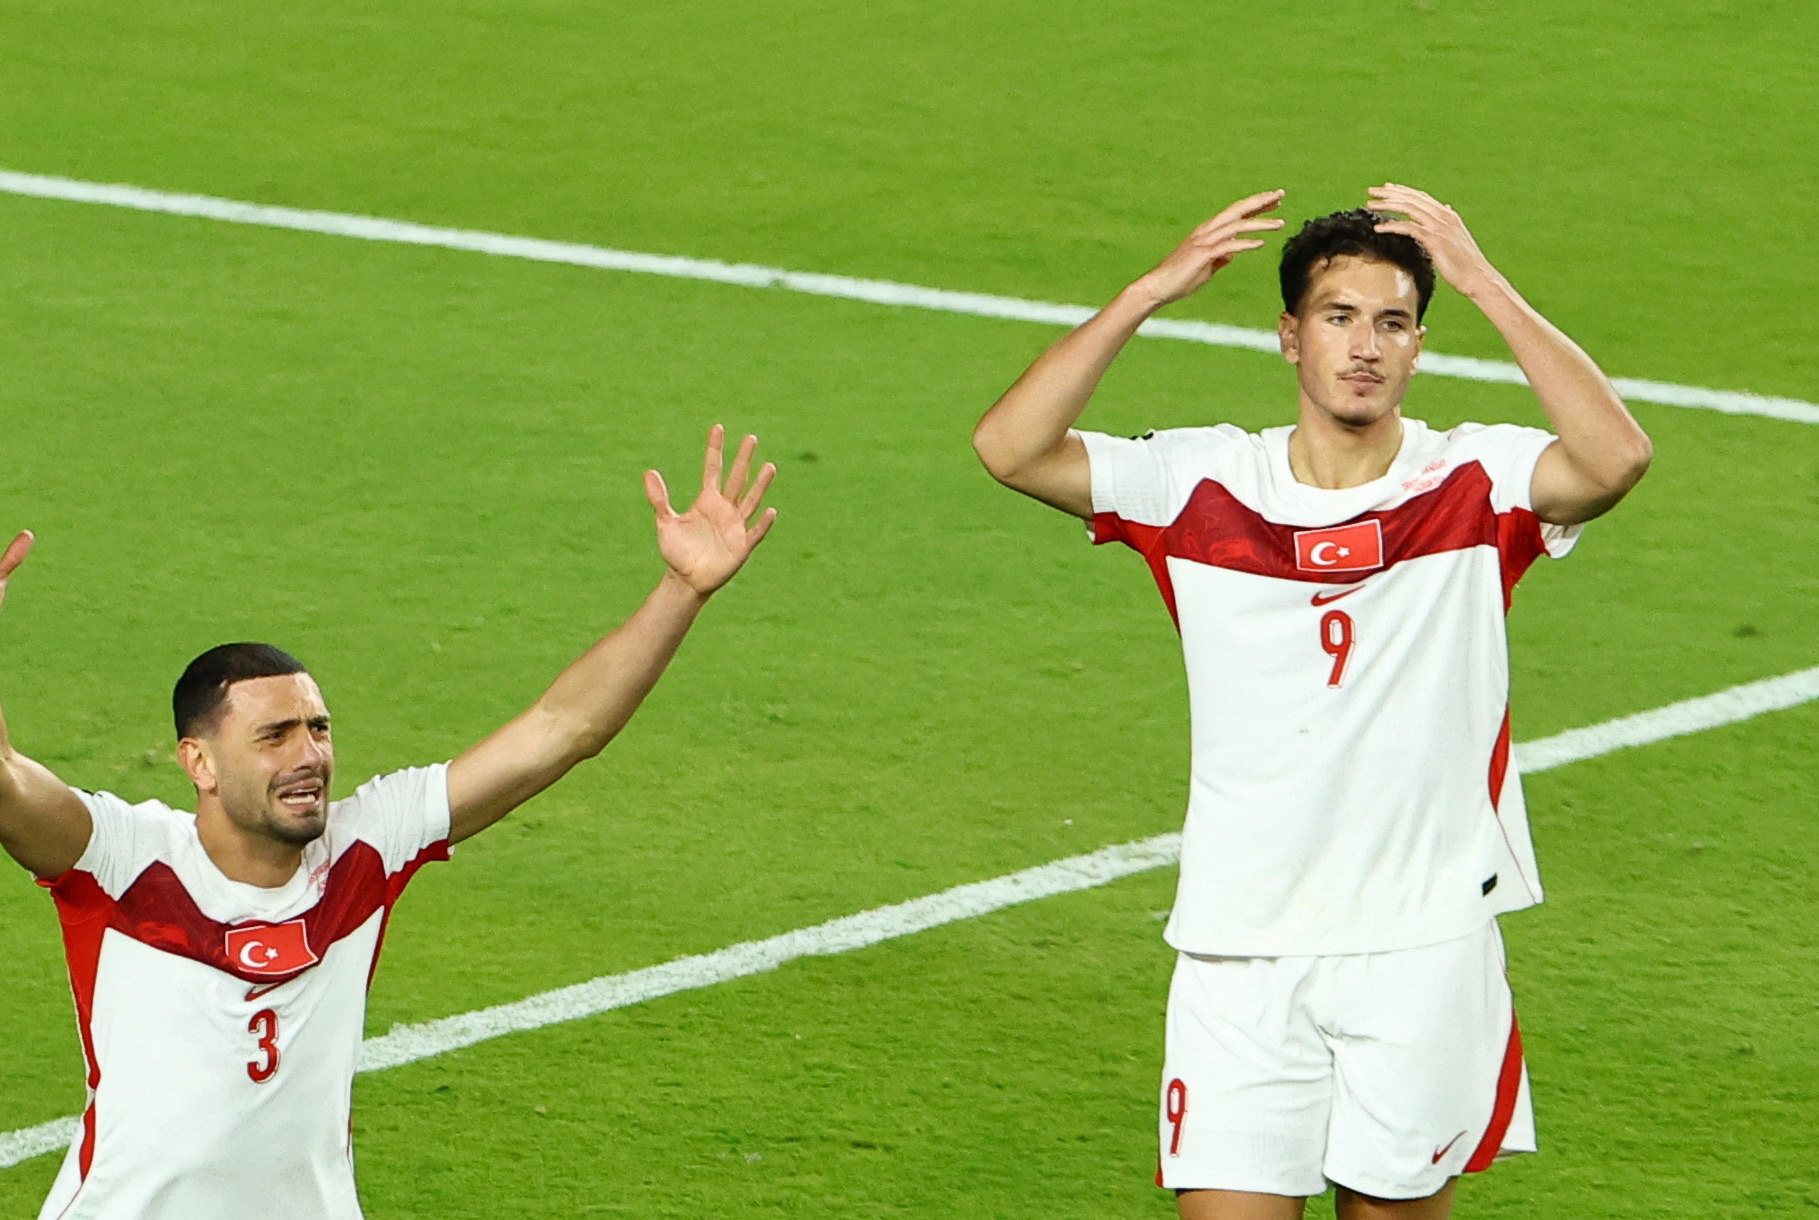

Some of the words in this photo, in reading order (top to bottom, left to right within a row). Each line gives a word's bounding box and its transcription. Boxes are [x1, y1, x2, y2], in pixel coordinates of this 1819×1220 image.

[1320, 609, 1356, 689] 9
[246, 1007, 282, 1085] 3
[1167, 1078, 1189, 1158] 9
